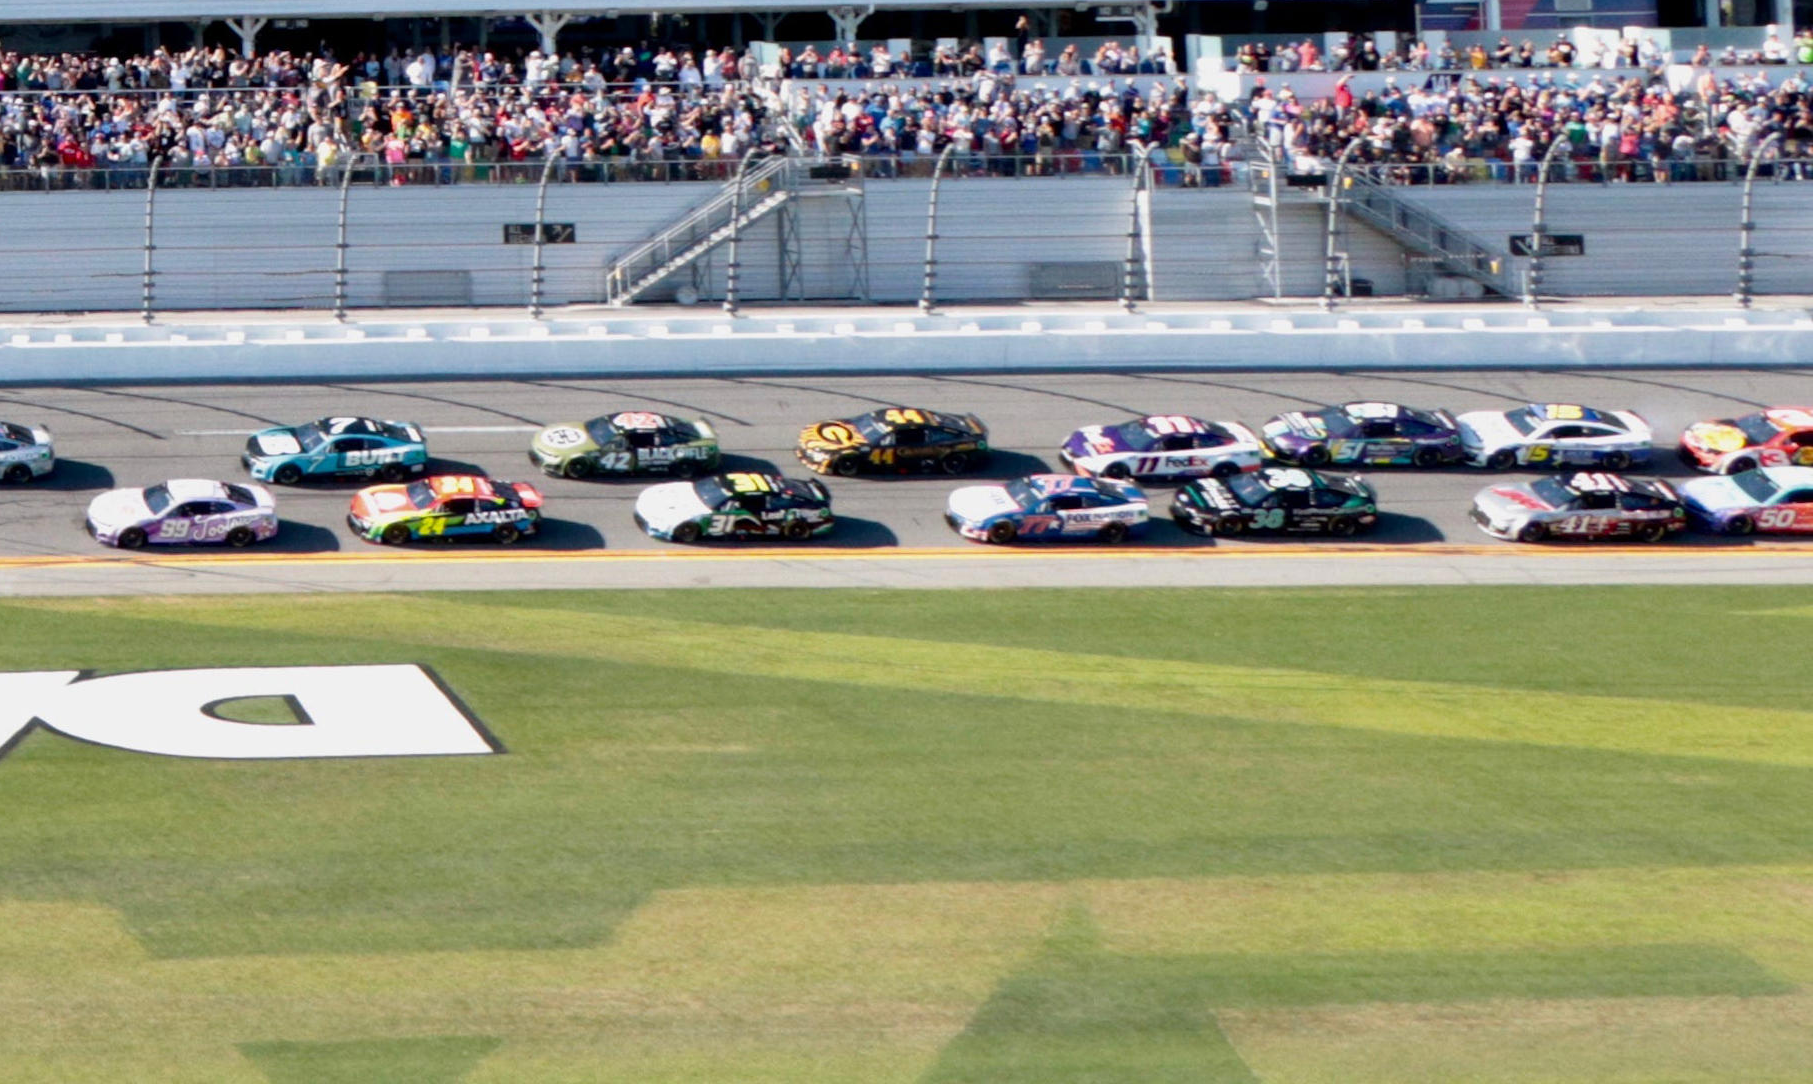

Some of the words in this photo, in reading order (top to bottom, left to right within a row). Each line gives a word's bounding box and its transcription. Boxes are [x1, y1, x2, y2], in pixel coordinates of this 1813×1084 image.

[885, 409, 925, 424] 44
[600, 453, 632, 470] 42
[637, 448, 676, 461] BLACK
[870, 449, 893, 464] 44
[1165, 456, 1209, 468] FedEx
[308, 456, 326, 473] 7
[1136, 457, 1159, 473] 11
[726, 473, 771, 492] 31
[464, 509, 528, 525] AXALTA
[1067, 512, 1091, 522] FOX
[1094, 510, 1134, 520] NATION
[1758, 508, 1796, 528] 50
[160, 519, 190, 538] 99
[418, 517, 448, 535] 24
[709, 515, 736, 536] 31
